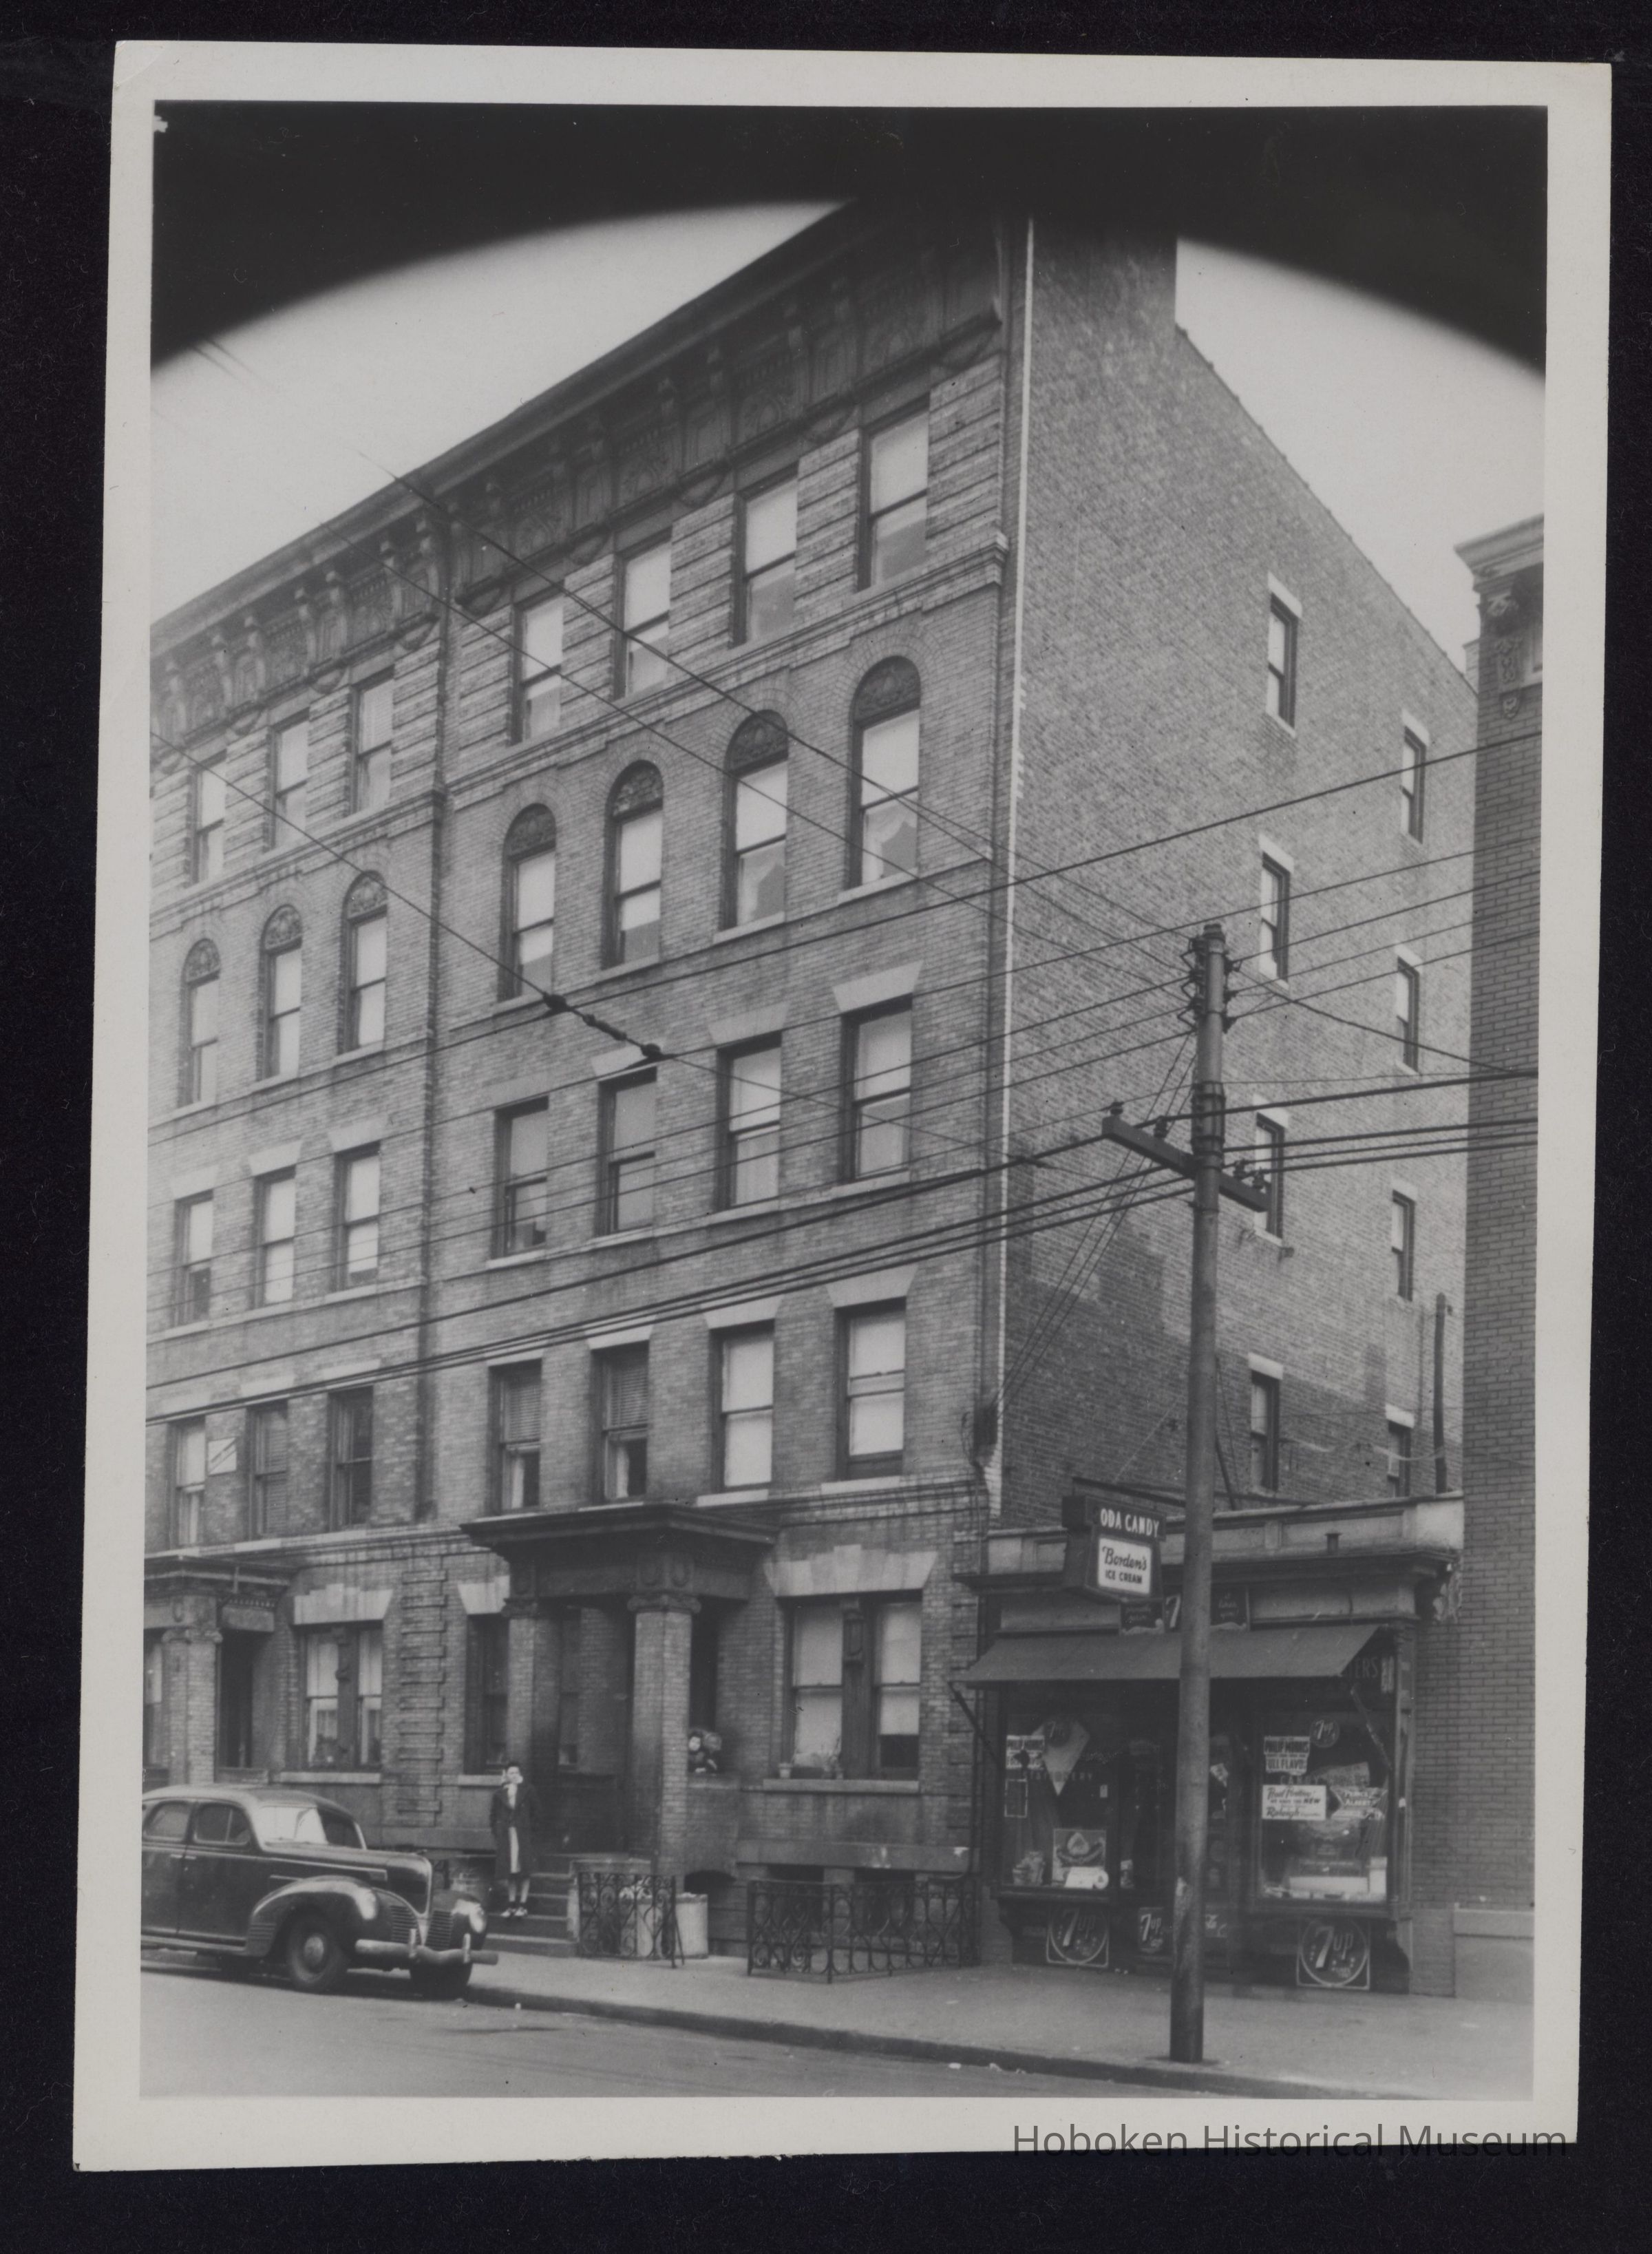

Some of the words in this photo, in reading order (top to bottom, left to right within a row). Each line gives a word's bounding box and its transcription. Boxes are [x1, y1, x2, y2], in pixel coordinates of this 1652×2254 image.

[1125, 1514, 1160, 1539] CANDY
[1101, 1546, 1147, 1571] Borden's
[1105, 1570, 1116, 1581] ICE
[1119, 1572, 1143, 1585] CREAM
